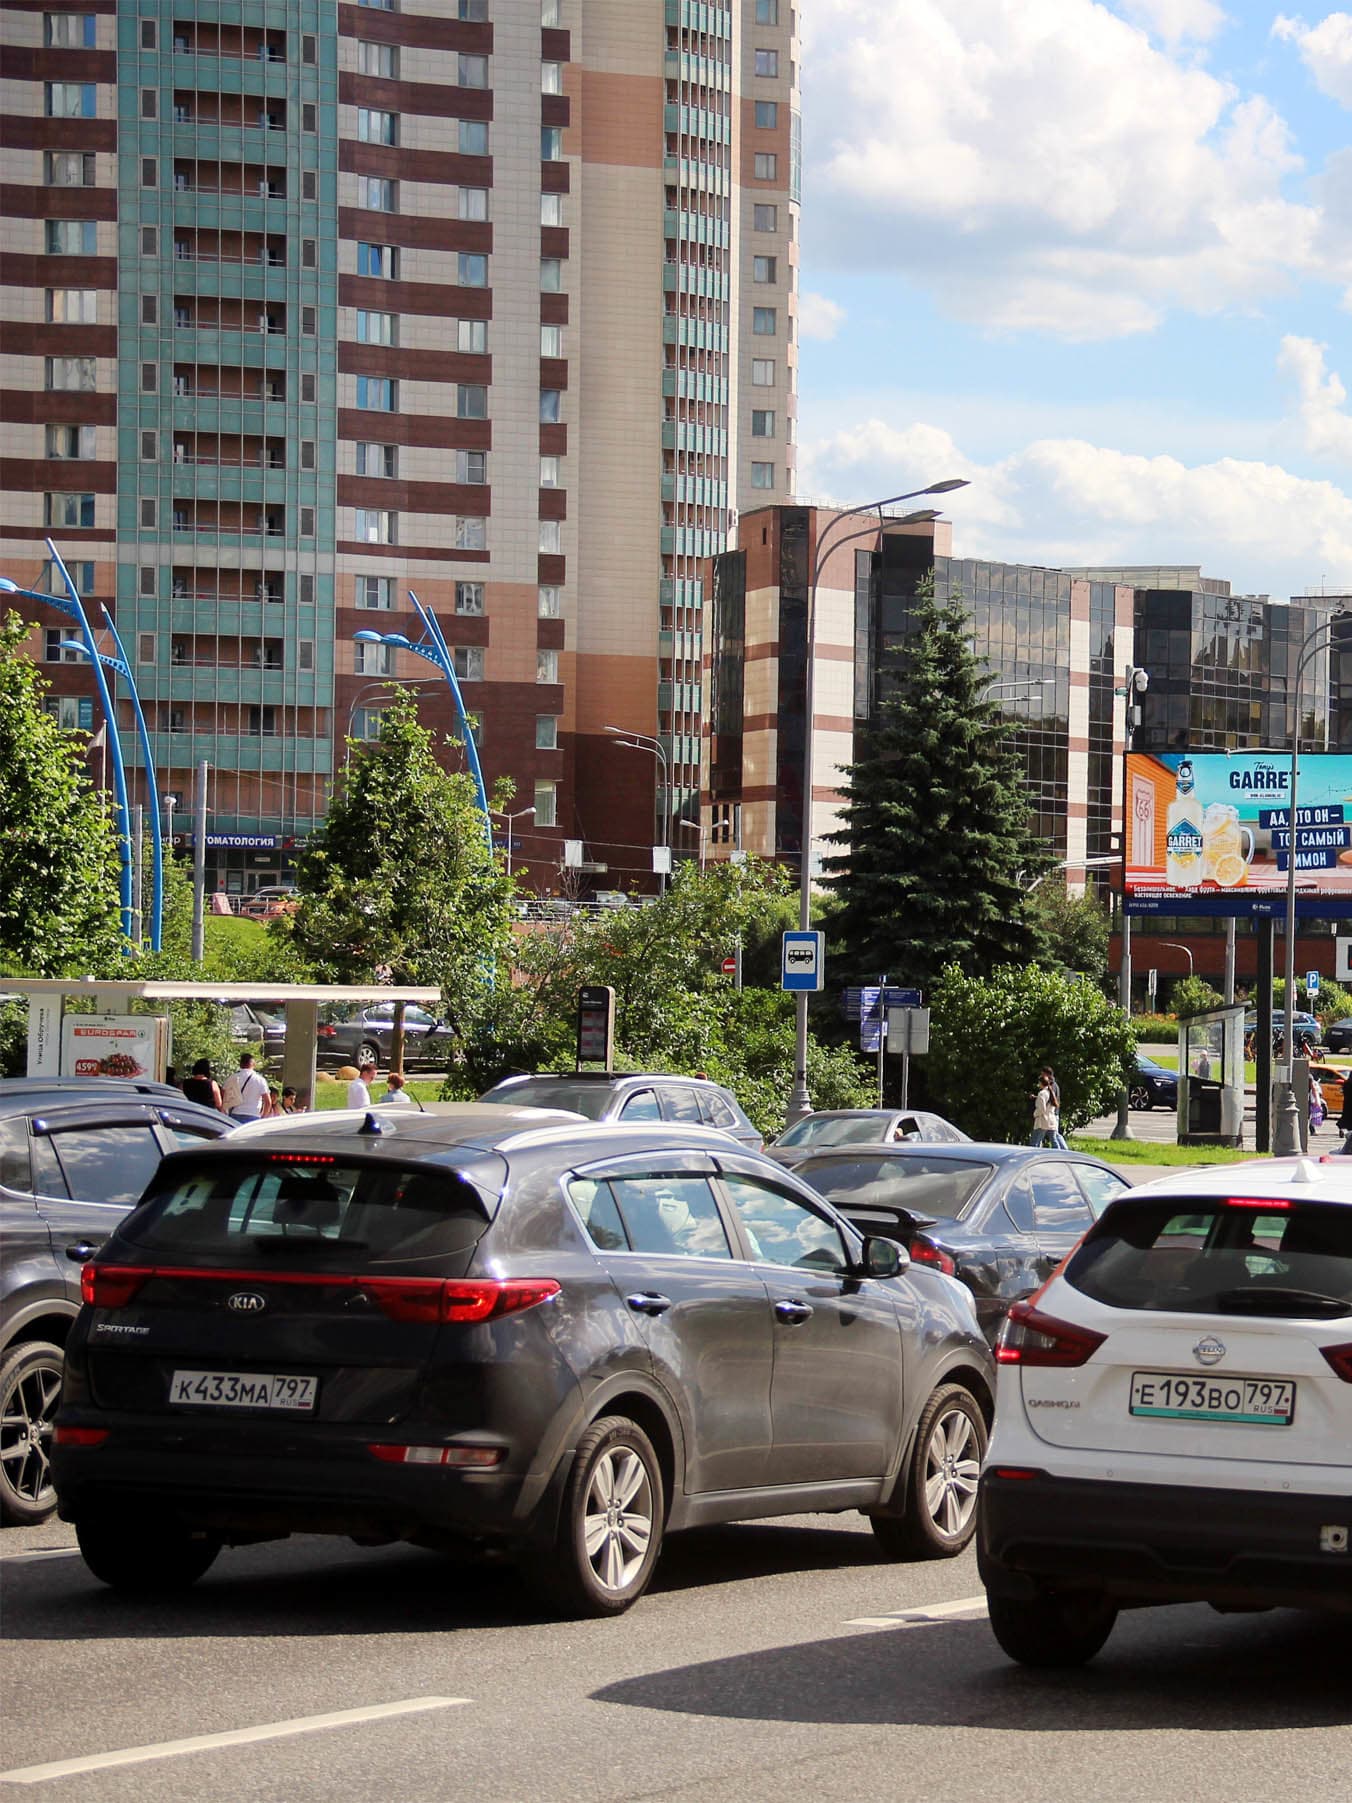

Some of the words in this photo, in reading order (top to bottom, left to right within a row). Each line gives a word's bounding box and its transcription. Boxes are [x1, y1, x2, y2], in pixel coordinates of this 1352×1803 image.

[1293, 809, 1311, 824] ТО
[194, 835, 275, 847] ОМАТОЛОГИЯ
[1168, 836, 1202, 847] GARRET
[1301, 829, 1344, 846] САМЫЙ
[1309, 973, 1317, 988] P
[80, 1029, 136, 1037] EUROSPAR
[233, 1296, 258, 1309] KIA
[96, 1323, 150, 1335] SPORTAGE
[275, 1377, 310, 1399] 797
[1246, 1382, 1286, 1406] 797
[280, 1398, 299, 1407] RUS
[1253, 1405, 1273, 1414] RUS
